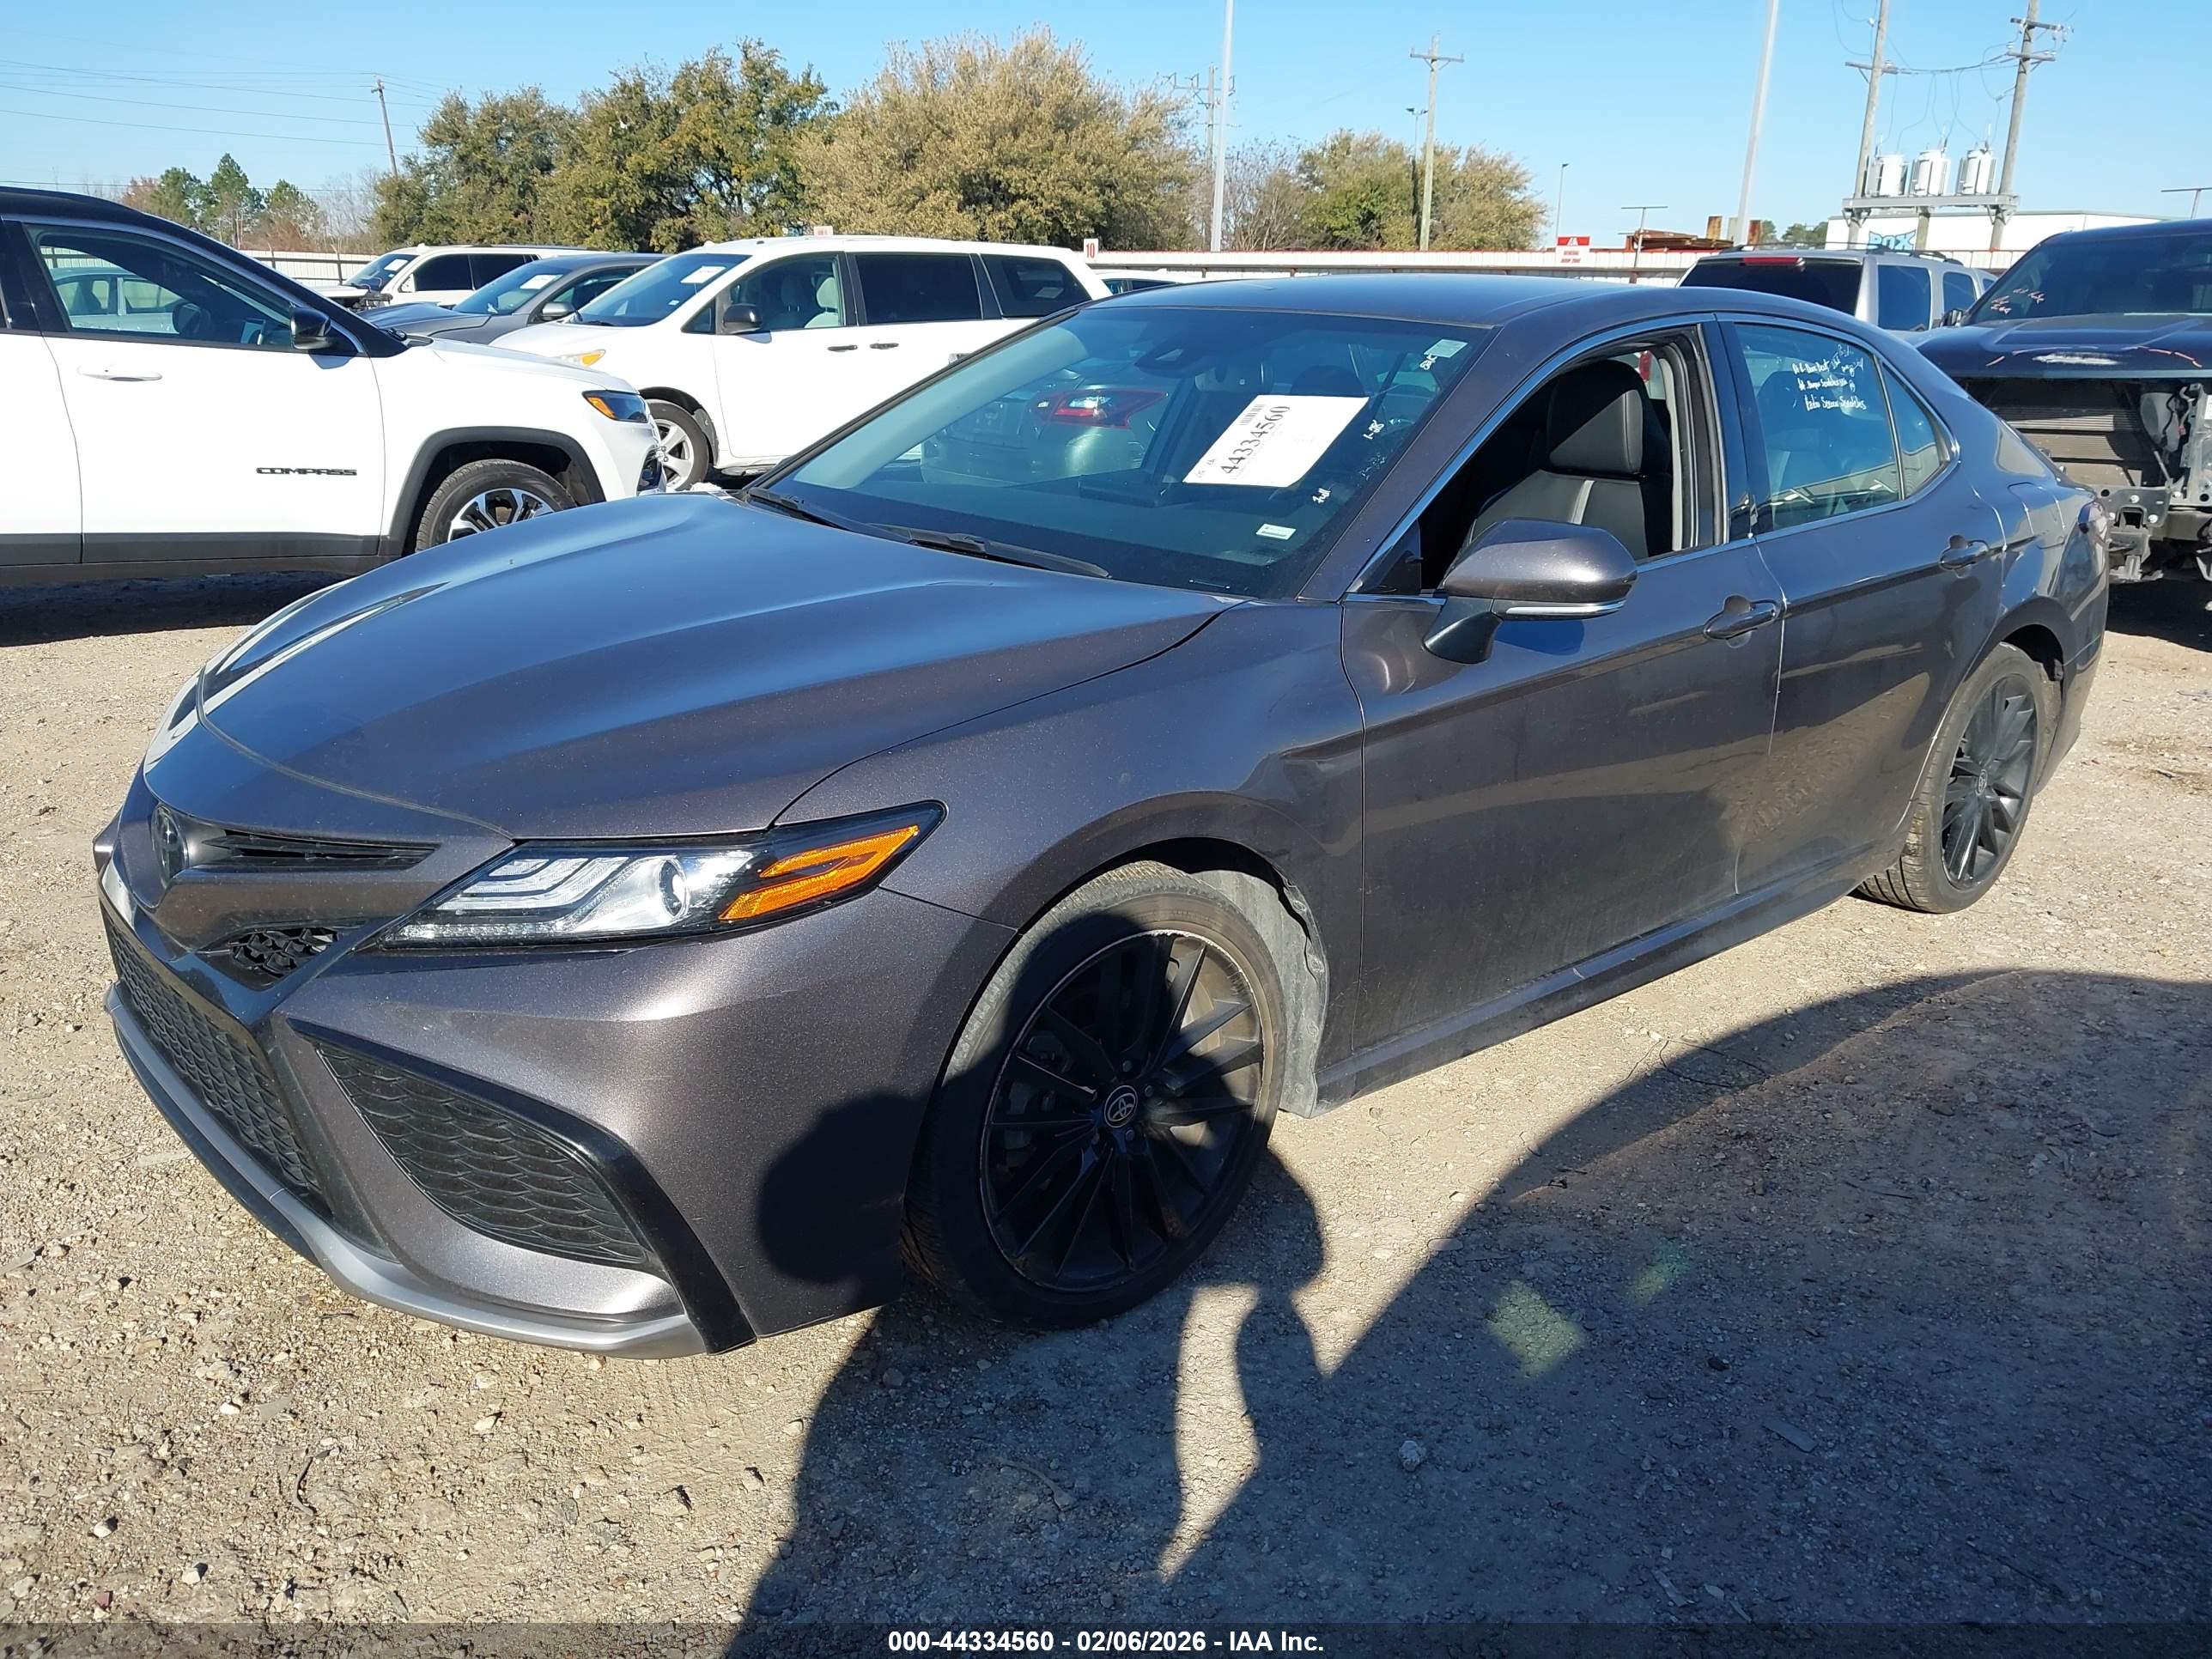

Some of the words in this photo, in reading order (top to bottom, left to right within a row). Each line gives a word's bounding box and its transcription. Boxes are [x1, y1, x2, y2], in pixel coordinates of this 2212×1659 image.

[1085, 243, 1095, 258] 10
[1220, 405, 1291, 474] 44334560
[256, 467, 357, 476] COMPASS
